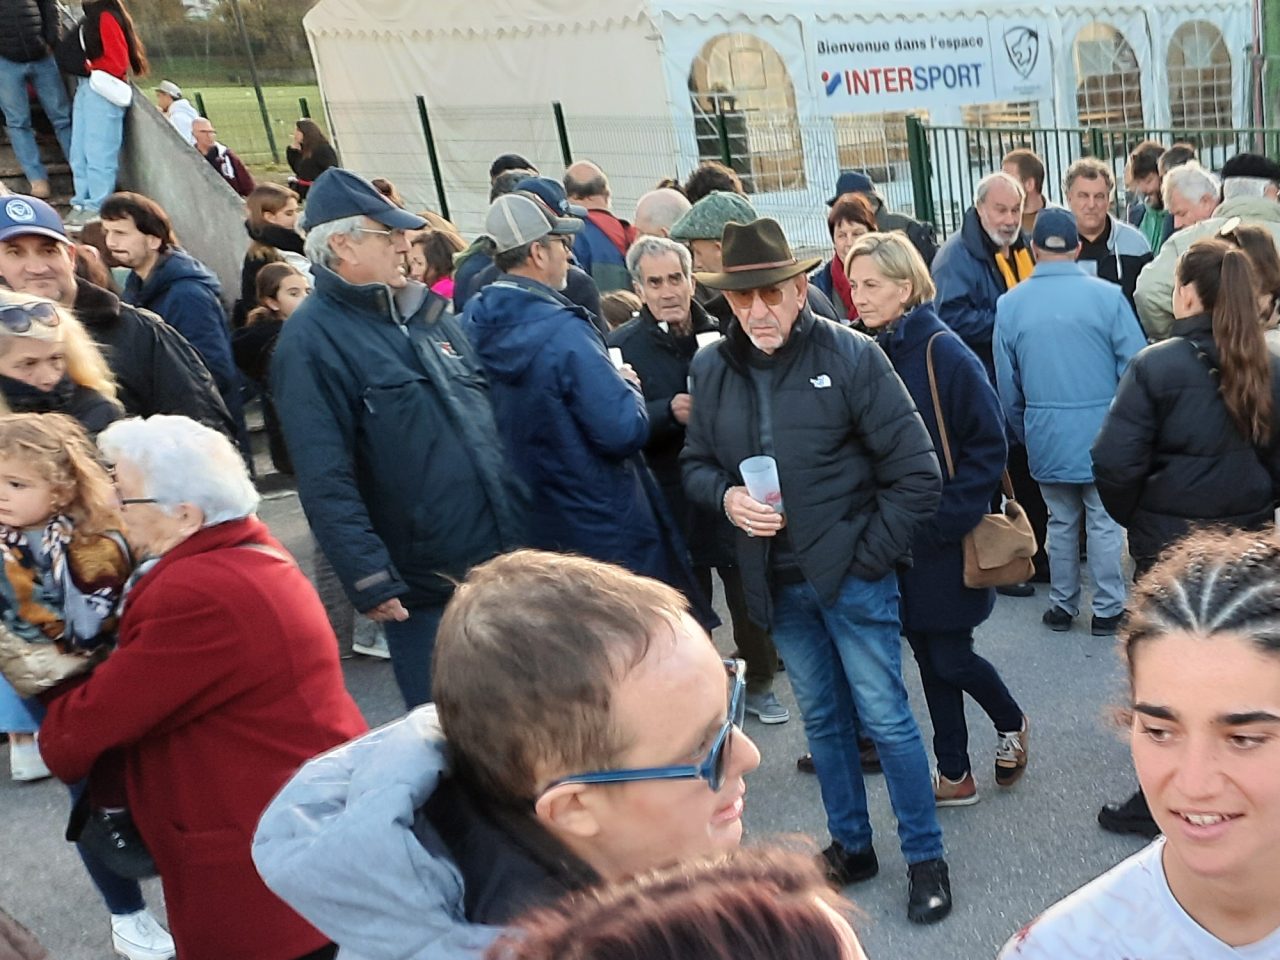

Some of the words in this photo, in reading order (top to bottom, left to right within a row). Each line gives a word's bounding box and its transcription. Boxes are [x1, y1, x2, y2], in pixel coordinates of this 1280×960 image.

[817, 40, 890, 55] Bienvenue
[894, 36, 926, 51] dans
[930, 35, 984, 51] l'espace
[844, 63, 982, 96] INTERSPORT
